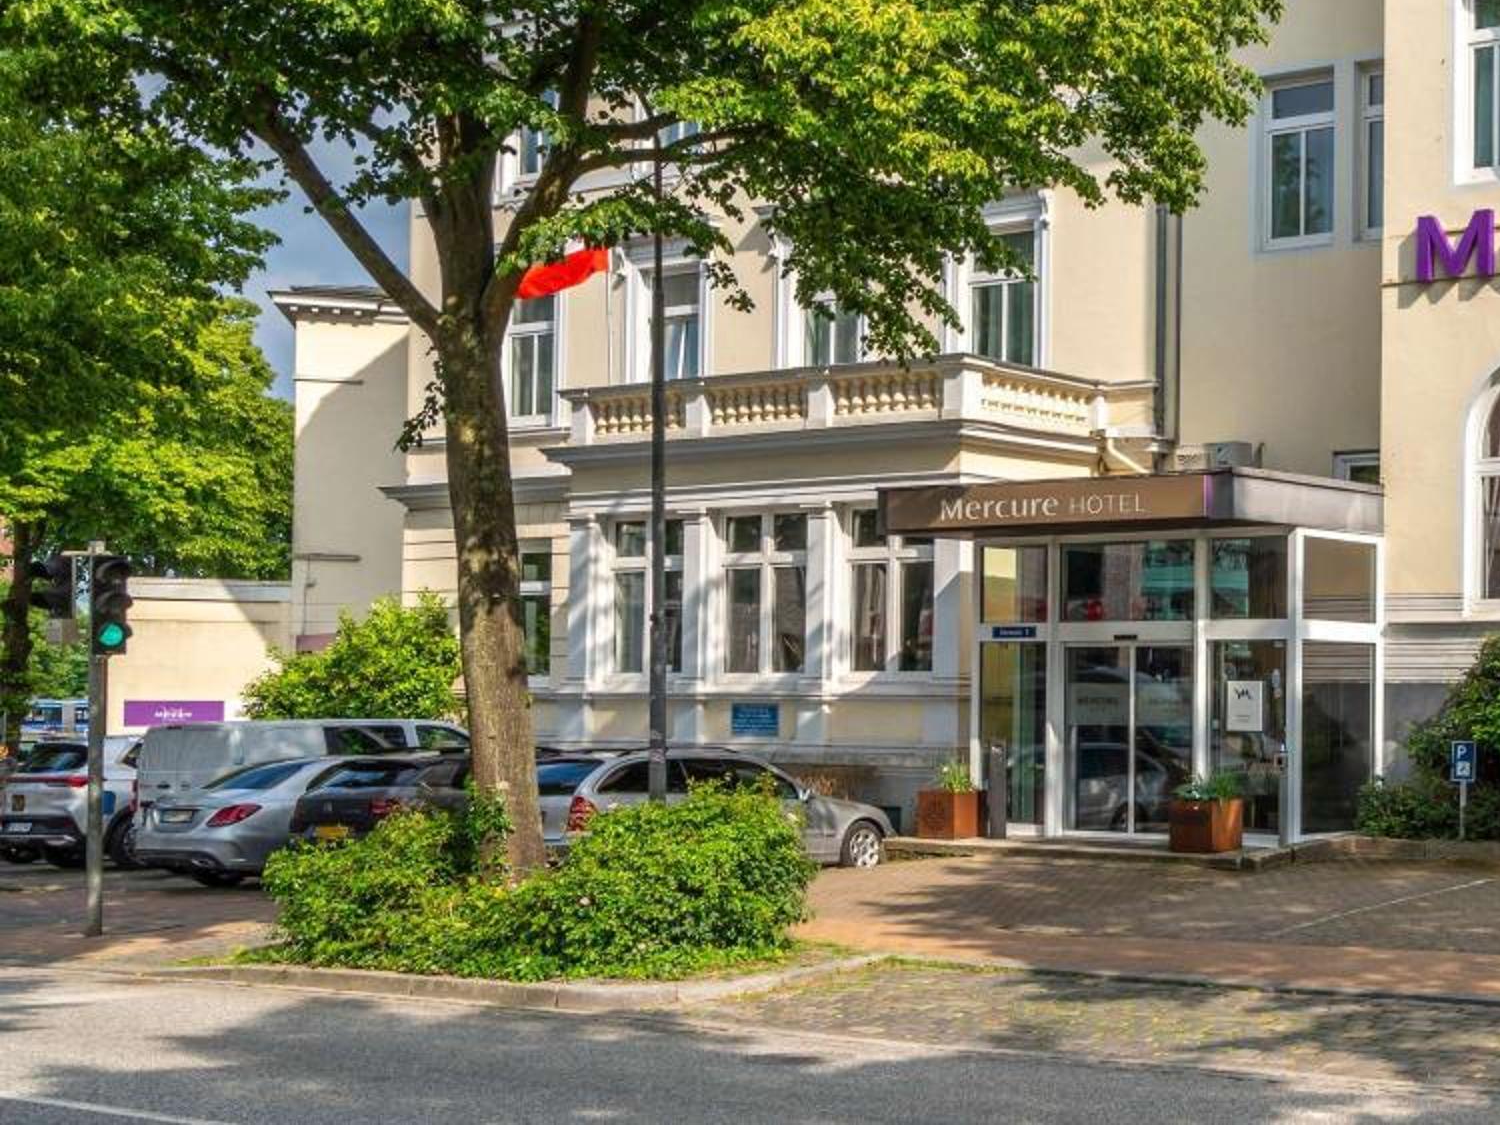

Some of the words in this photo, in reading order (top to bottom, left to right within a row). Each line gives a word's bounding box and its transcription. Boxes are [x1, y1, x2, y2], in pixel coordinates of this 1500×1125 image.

[940, 495, 1059, 521] Mercure
[1069, 493, 1146, 516] HOTEL
[1456, 745, 1467, 759] P
